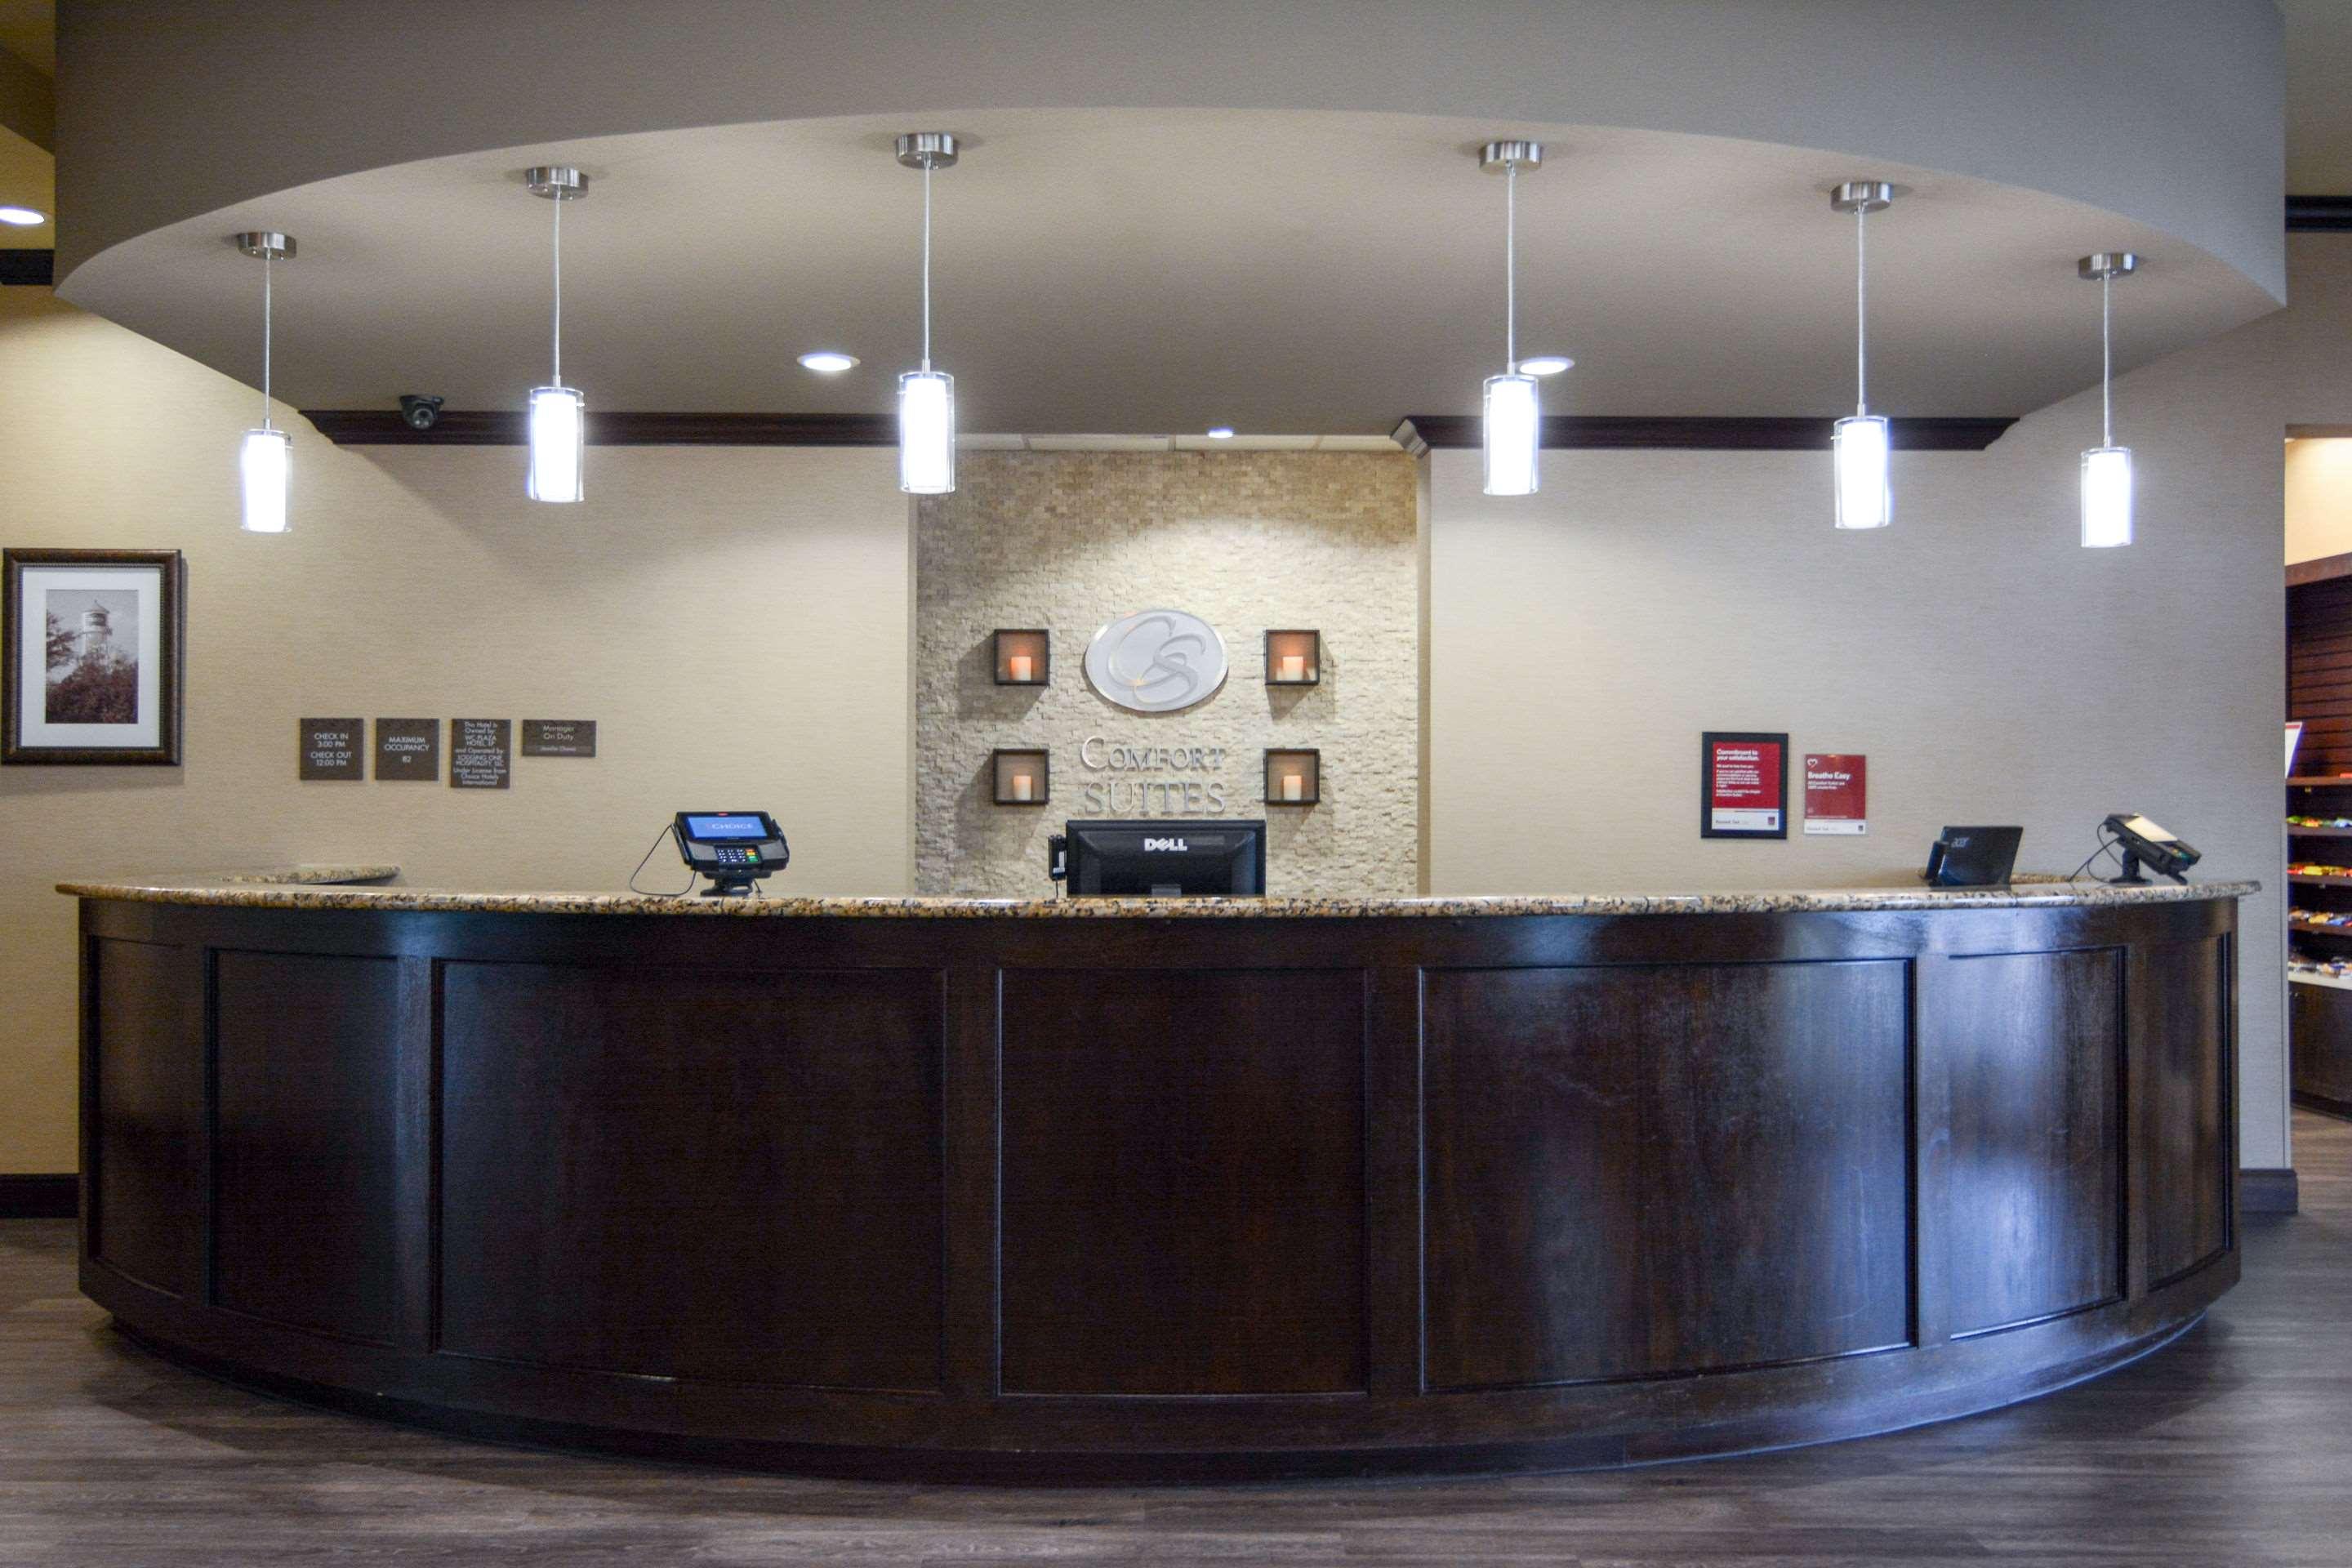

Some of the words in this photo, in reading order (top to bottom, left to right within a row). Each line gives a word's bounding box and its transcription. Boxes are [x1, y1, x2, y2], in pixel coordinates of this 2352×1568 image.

[543, 724, 575, 733] Manager
[557, 733, 574, 742] Duty
[385, 743, 430, 751] OCCUPANCY
[1807, 771, 1833, 779] Breathe
[1834, 771, 1851, 781] Easy
[1085, 781, 1225, 815] SUITES
[1144, 838, 1188, 851] DELL
